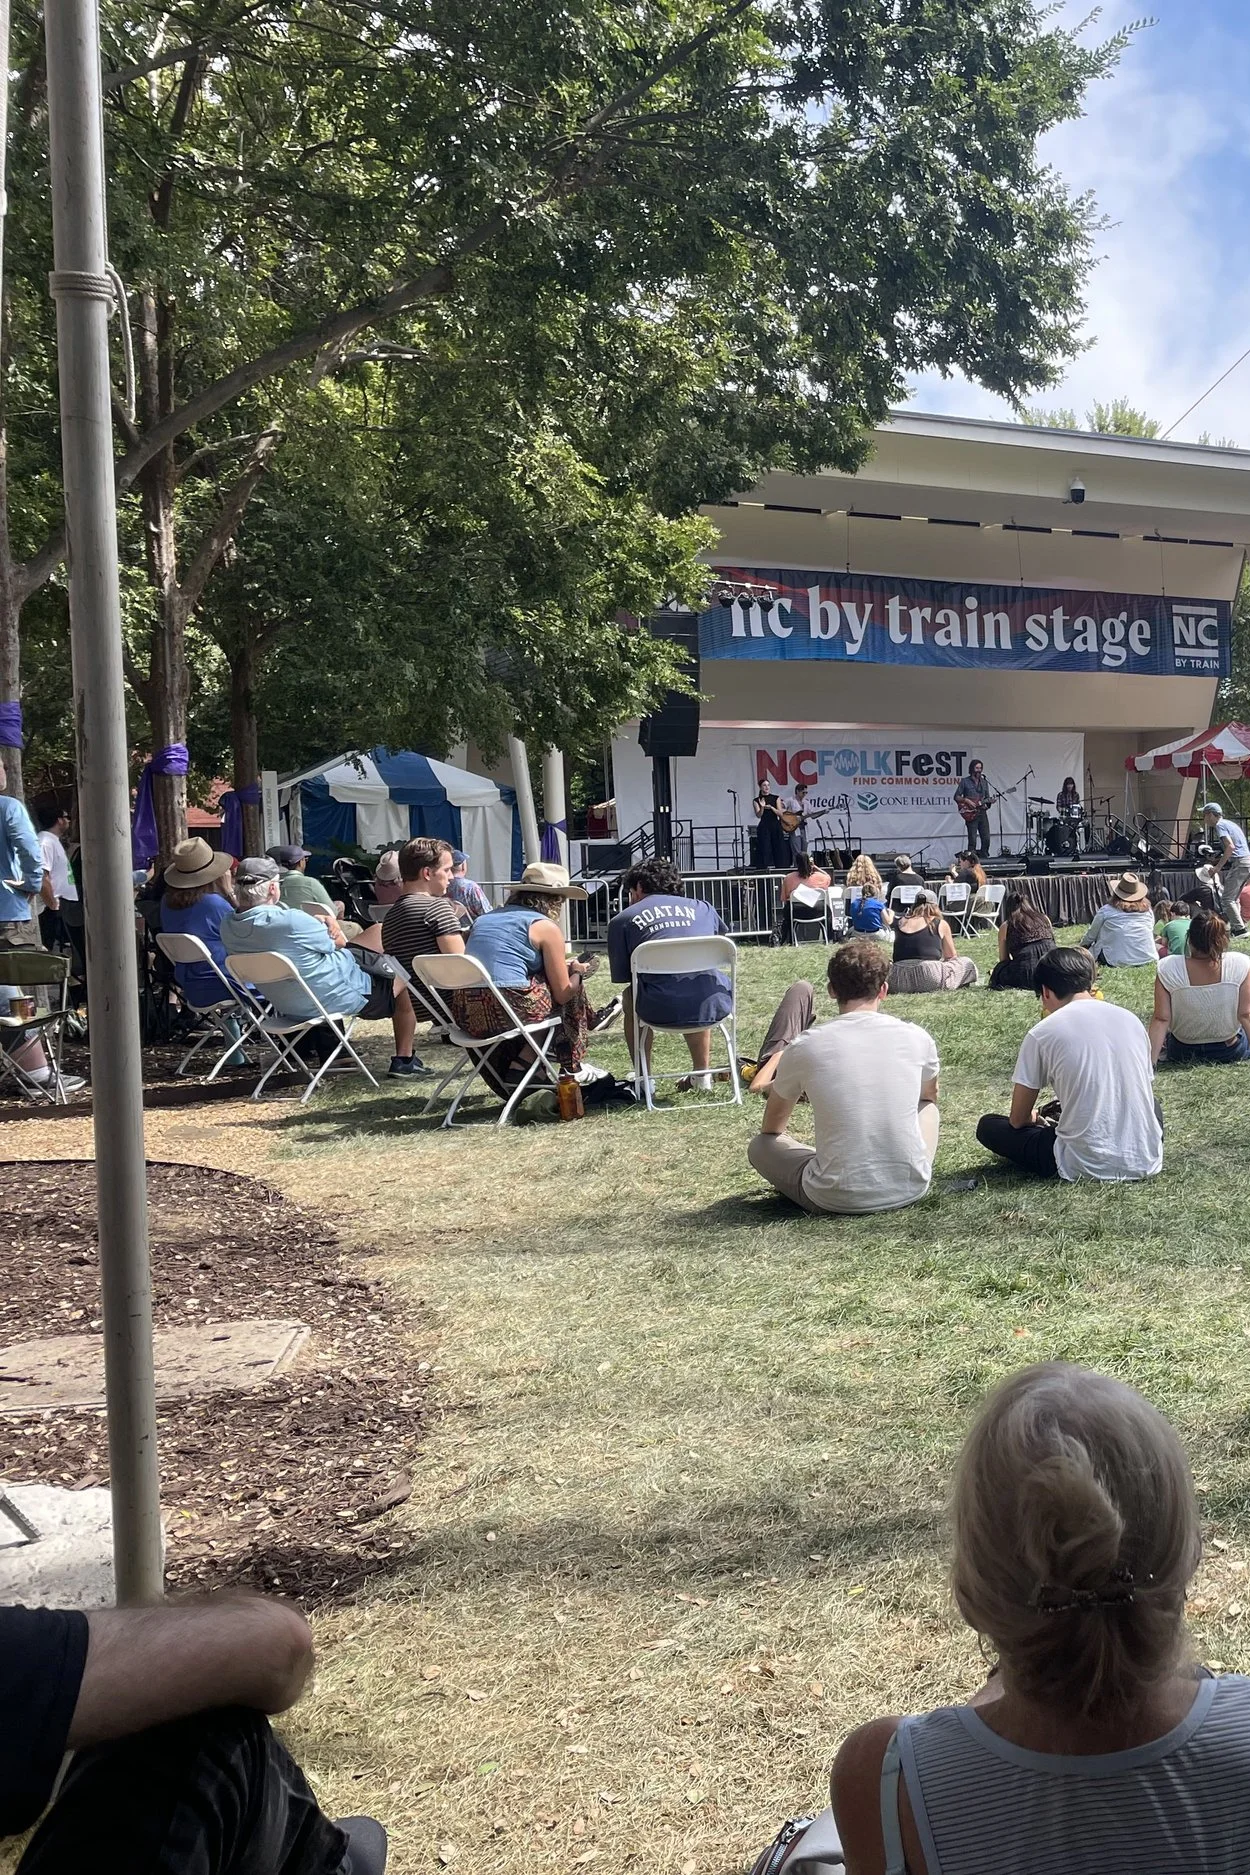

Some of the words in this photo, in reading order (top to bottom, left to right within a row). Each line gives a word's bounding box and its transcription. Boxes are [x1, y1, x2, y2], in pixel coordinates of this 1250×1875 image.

[732, 597, 793, 638] nc
[808, 585, 873, 655] by
[885, 595, 1012, 649] train
[1025, 606, 1150, 667] stage
[1173, 616, 1218, 647] NC
[1175, 658, 1187, 668] BY
[1190, 659, 1220, 669] TRAIN
[853, 777, 877, 785] FIND
[881, 777, 929, 785] COMMON
[880, 796, 909, 806] CONE
[632, 905, 696, 930] ROATAN
[649, 920, 692, 933] HONDURAS
